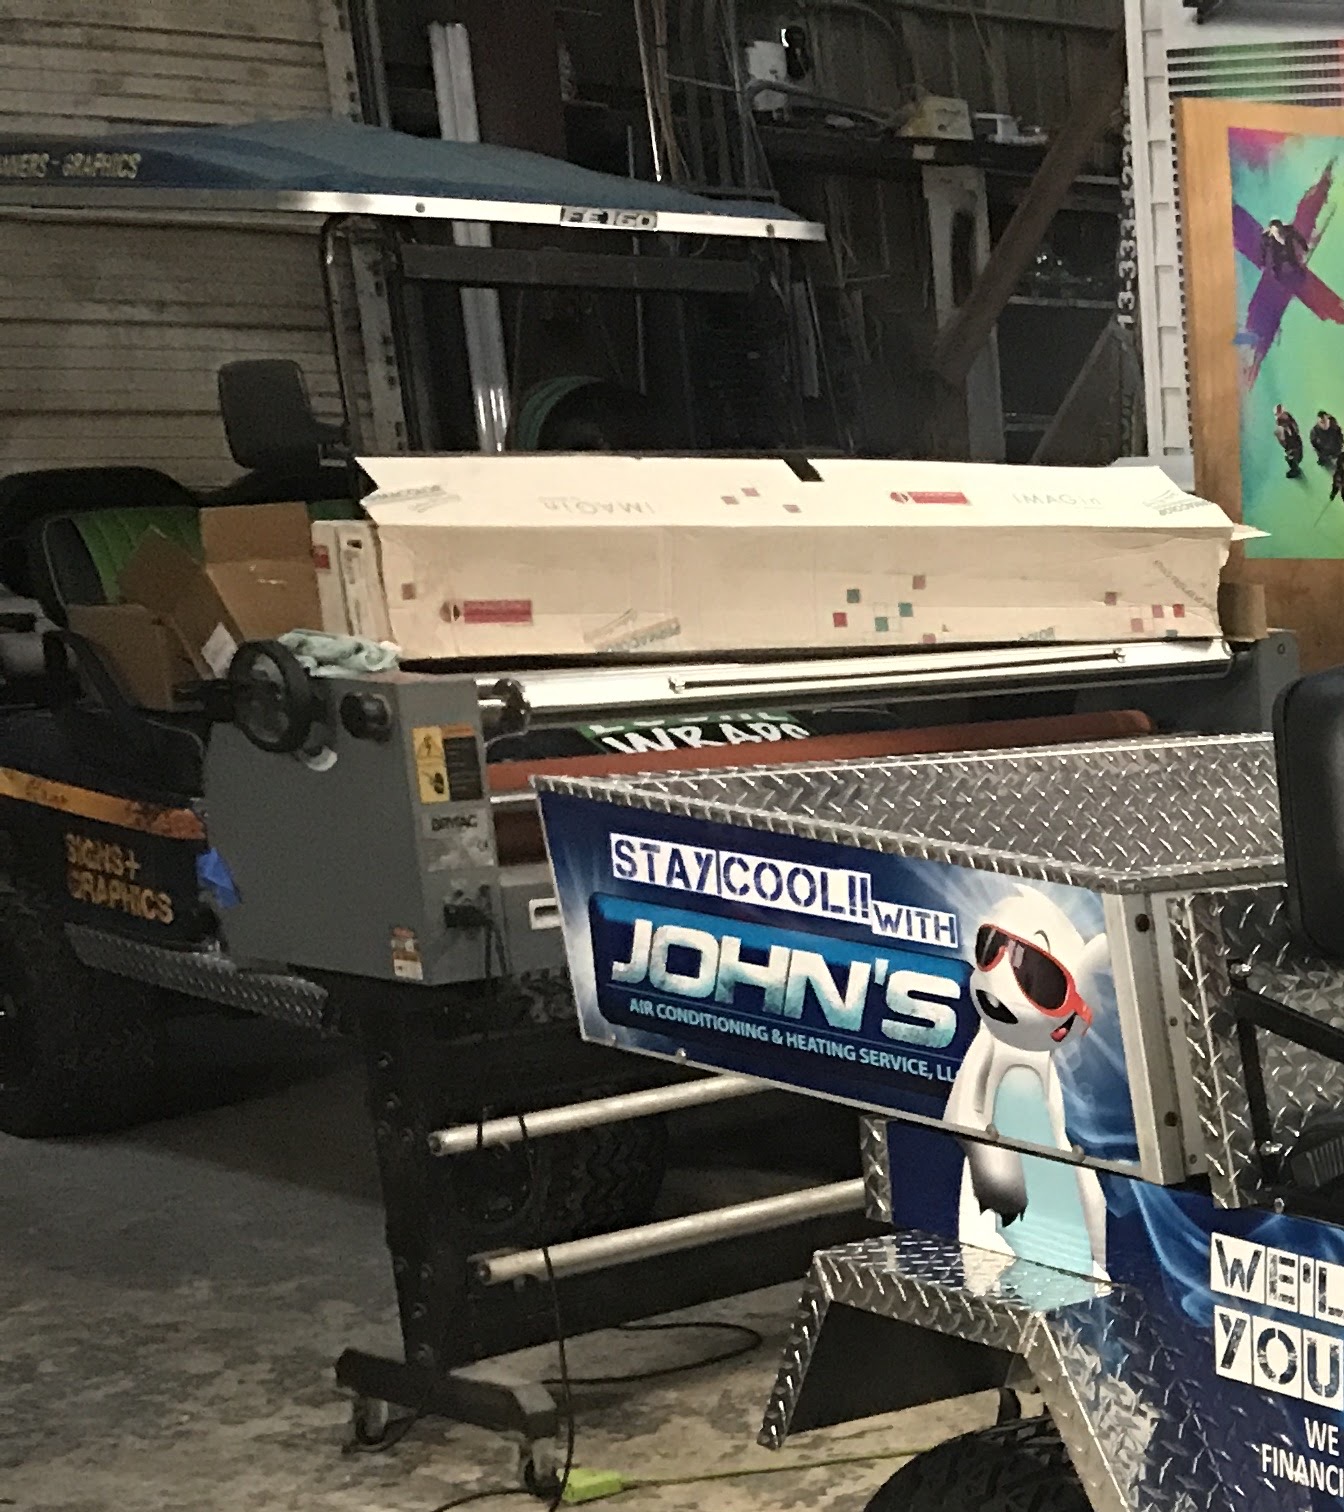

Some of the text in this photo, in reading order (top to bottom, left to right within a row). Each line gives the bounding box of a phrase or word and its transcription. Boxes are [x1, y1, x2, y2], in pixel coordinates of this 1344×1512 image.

[67, 869, 174, 925] GRAPHICS
[873, 903, 957, 945] WITH
[611, 918, 961, 1049] JOHN'S
[629, 999, 654, 1017] AIR
[655, 1003, 770, 1042] CONDITIONING
[771, 1029, 784, 1046] &
[786, 1032, 857, 1062] HEATING
[859, 1047, 934, 1081] SERVICE,
[1219, 1312, 1344, 1399] YOU
[1304, 1416, 1340, 1457] WE
